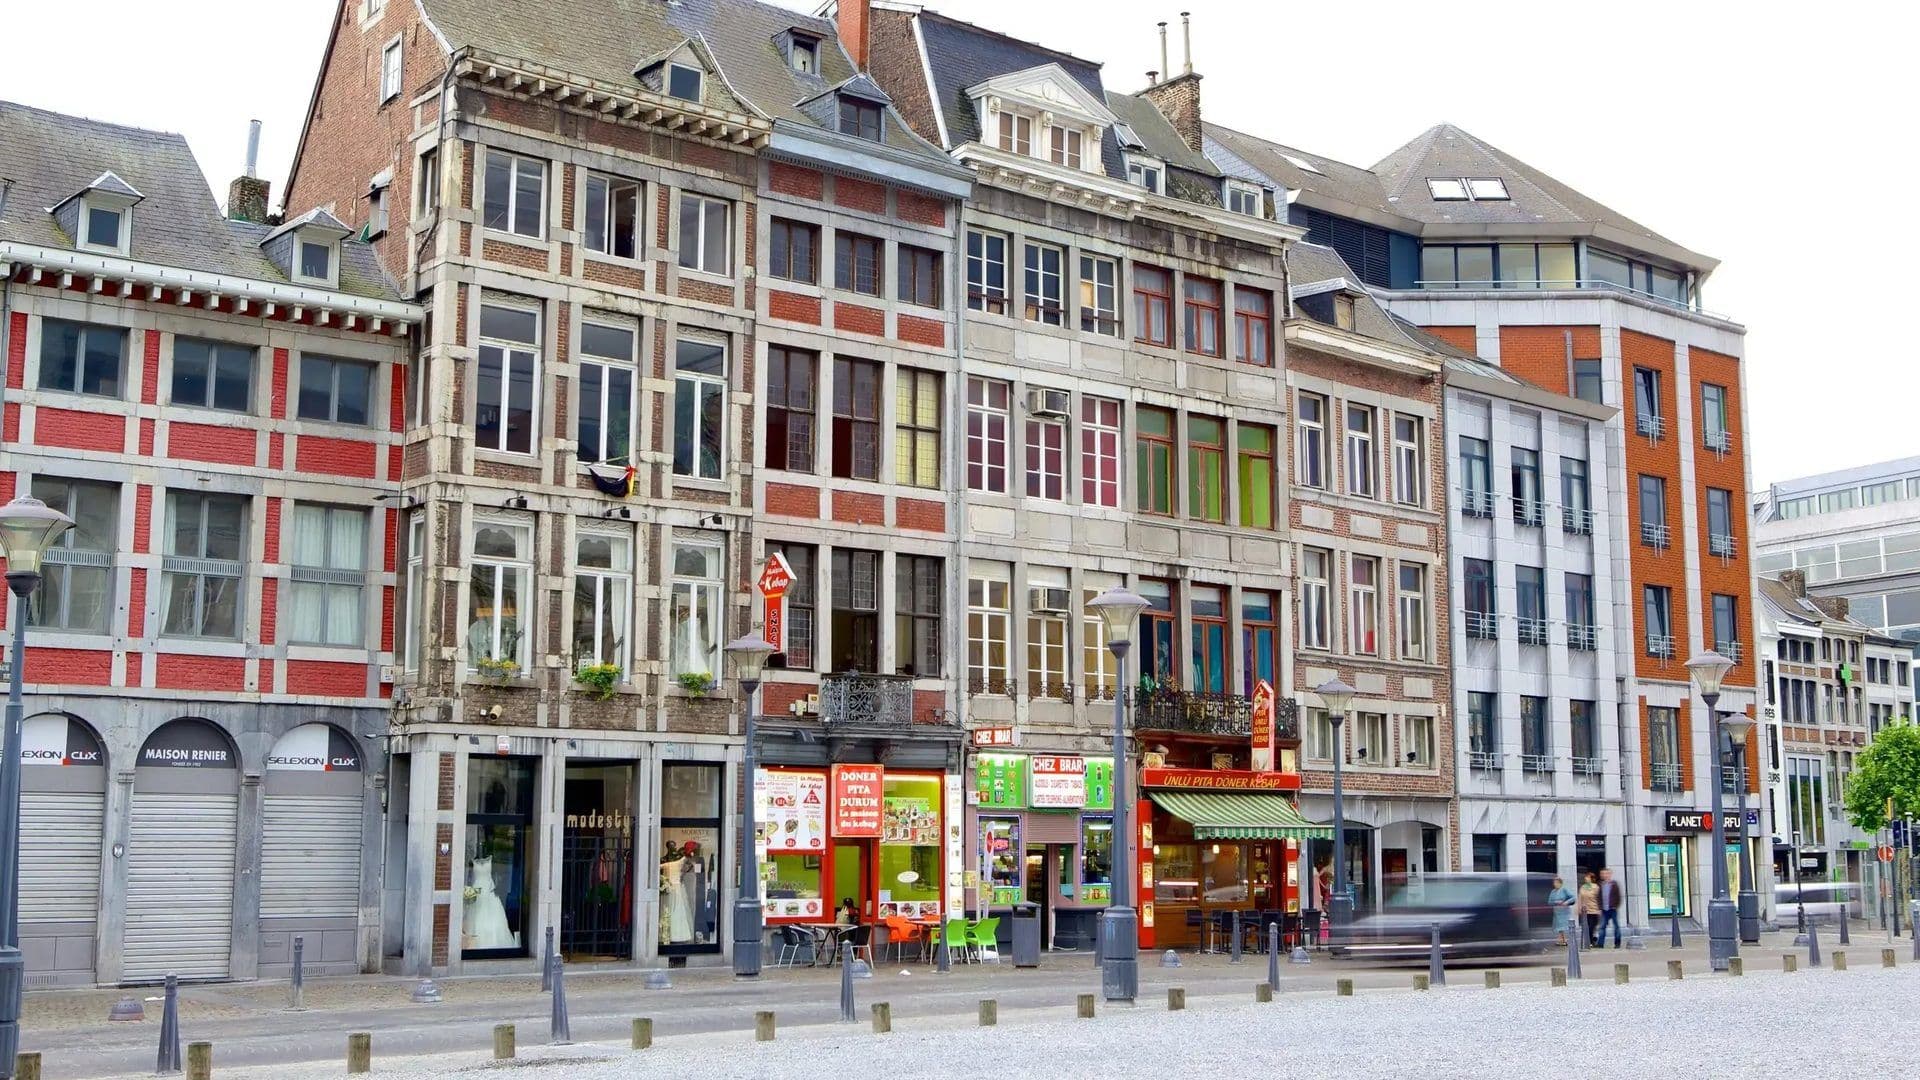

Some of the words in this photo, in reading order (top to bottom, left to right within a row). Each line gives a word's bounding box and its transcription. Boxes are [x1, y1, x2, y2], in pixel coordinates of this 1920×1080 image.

[975, 730, 992, 745] CHEZ
[994, 728, 1011, 744] BRAR
[145, 749, 188, 760] MAISON
[192, 750, 227, 761] RENIER
[1033, 757, 1056, 771] CHEZ
[1059, 758, 1083, 772] BRAR
[1193, 776, 1213, 787] PITA
[1250, 777, 1281, 789] KEBAP
[847, 785, 871, 794] PITA
[840, 797, 878, 807] DURUM
[567, 808, 632, 836] modesty
[1669, 815, 1702, 827] PLANET
